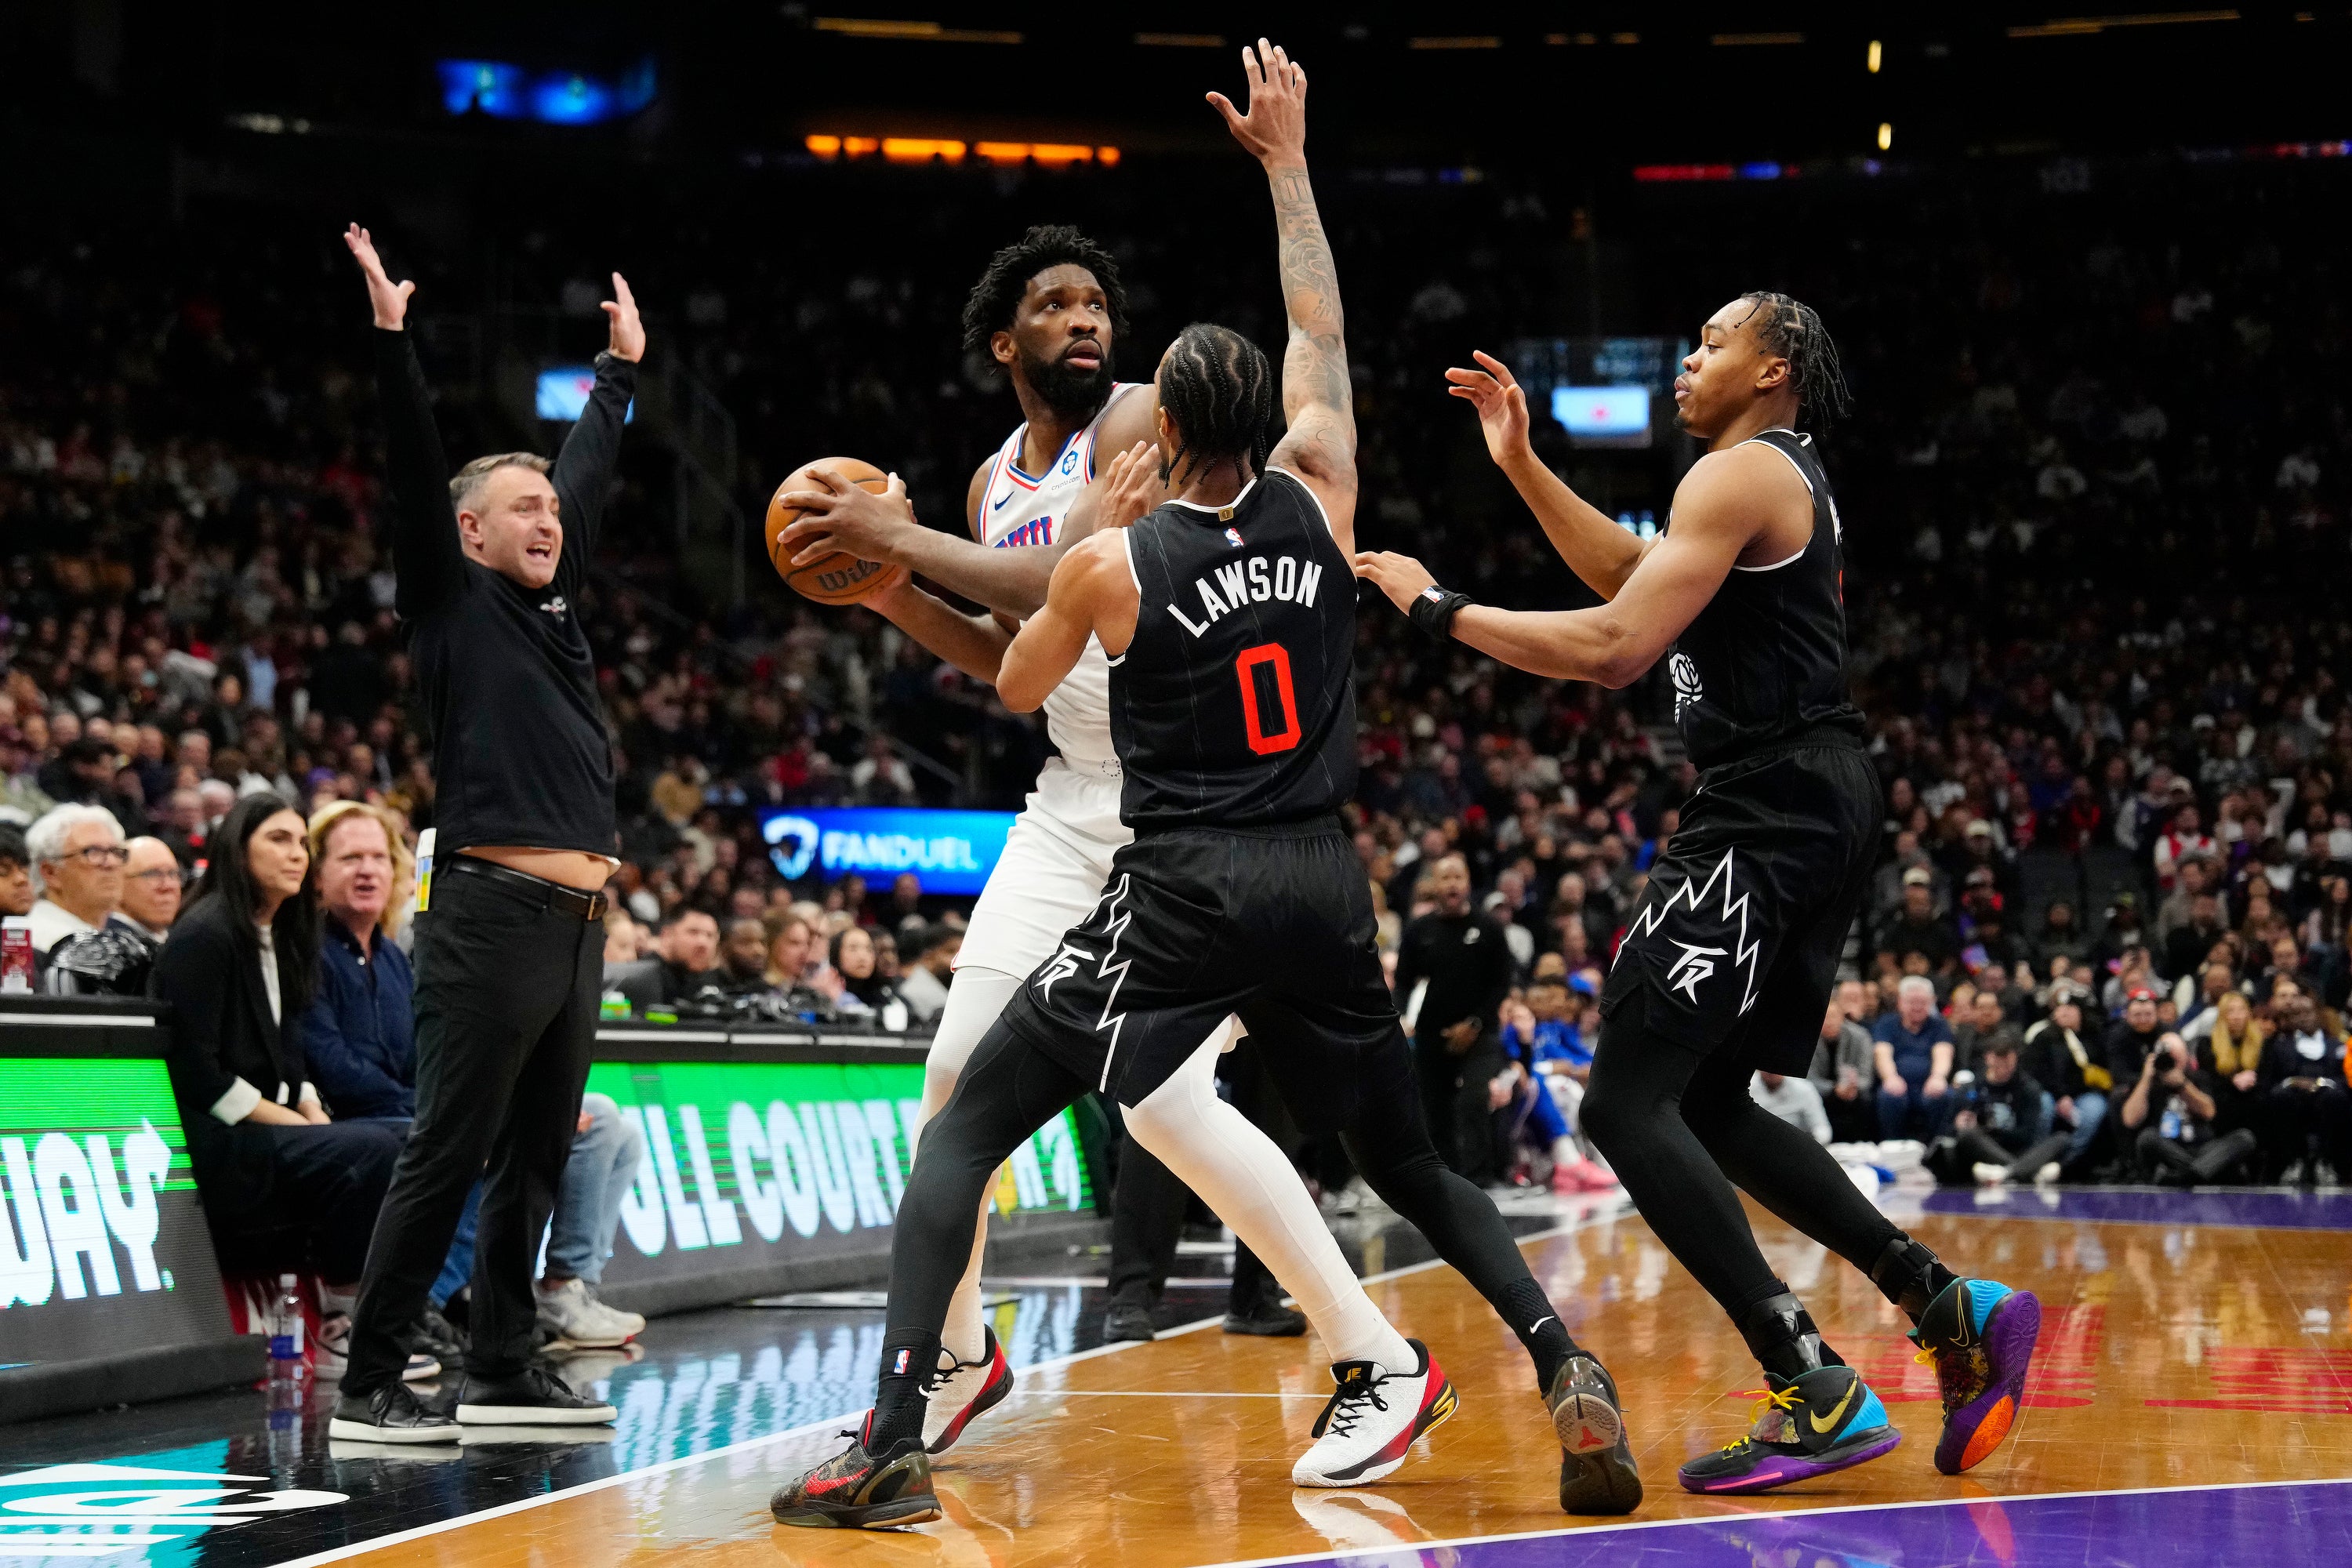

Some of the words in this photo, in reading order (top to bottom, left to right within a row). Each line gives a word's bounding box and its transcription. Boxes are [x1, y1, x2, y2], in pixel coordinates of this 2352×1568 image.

[815, 559, 882, 592] Wils
[1167, 556, 1323, 638] LAWSON
[1236, 642, 1301, 756] 0
[822, 831, 980, 872] FANDUEL
[728, 1099, 906, 1244] COURT
